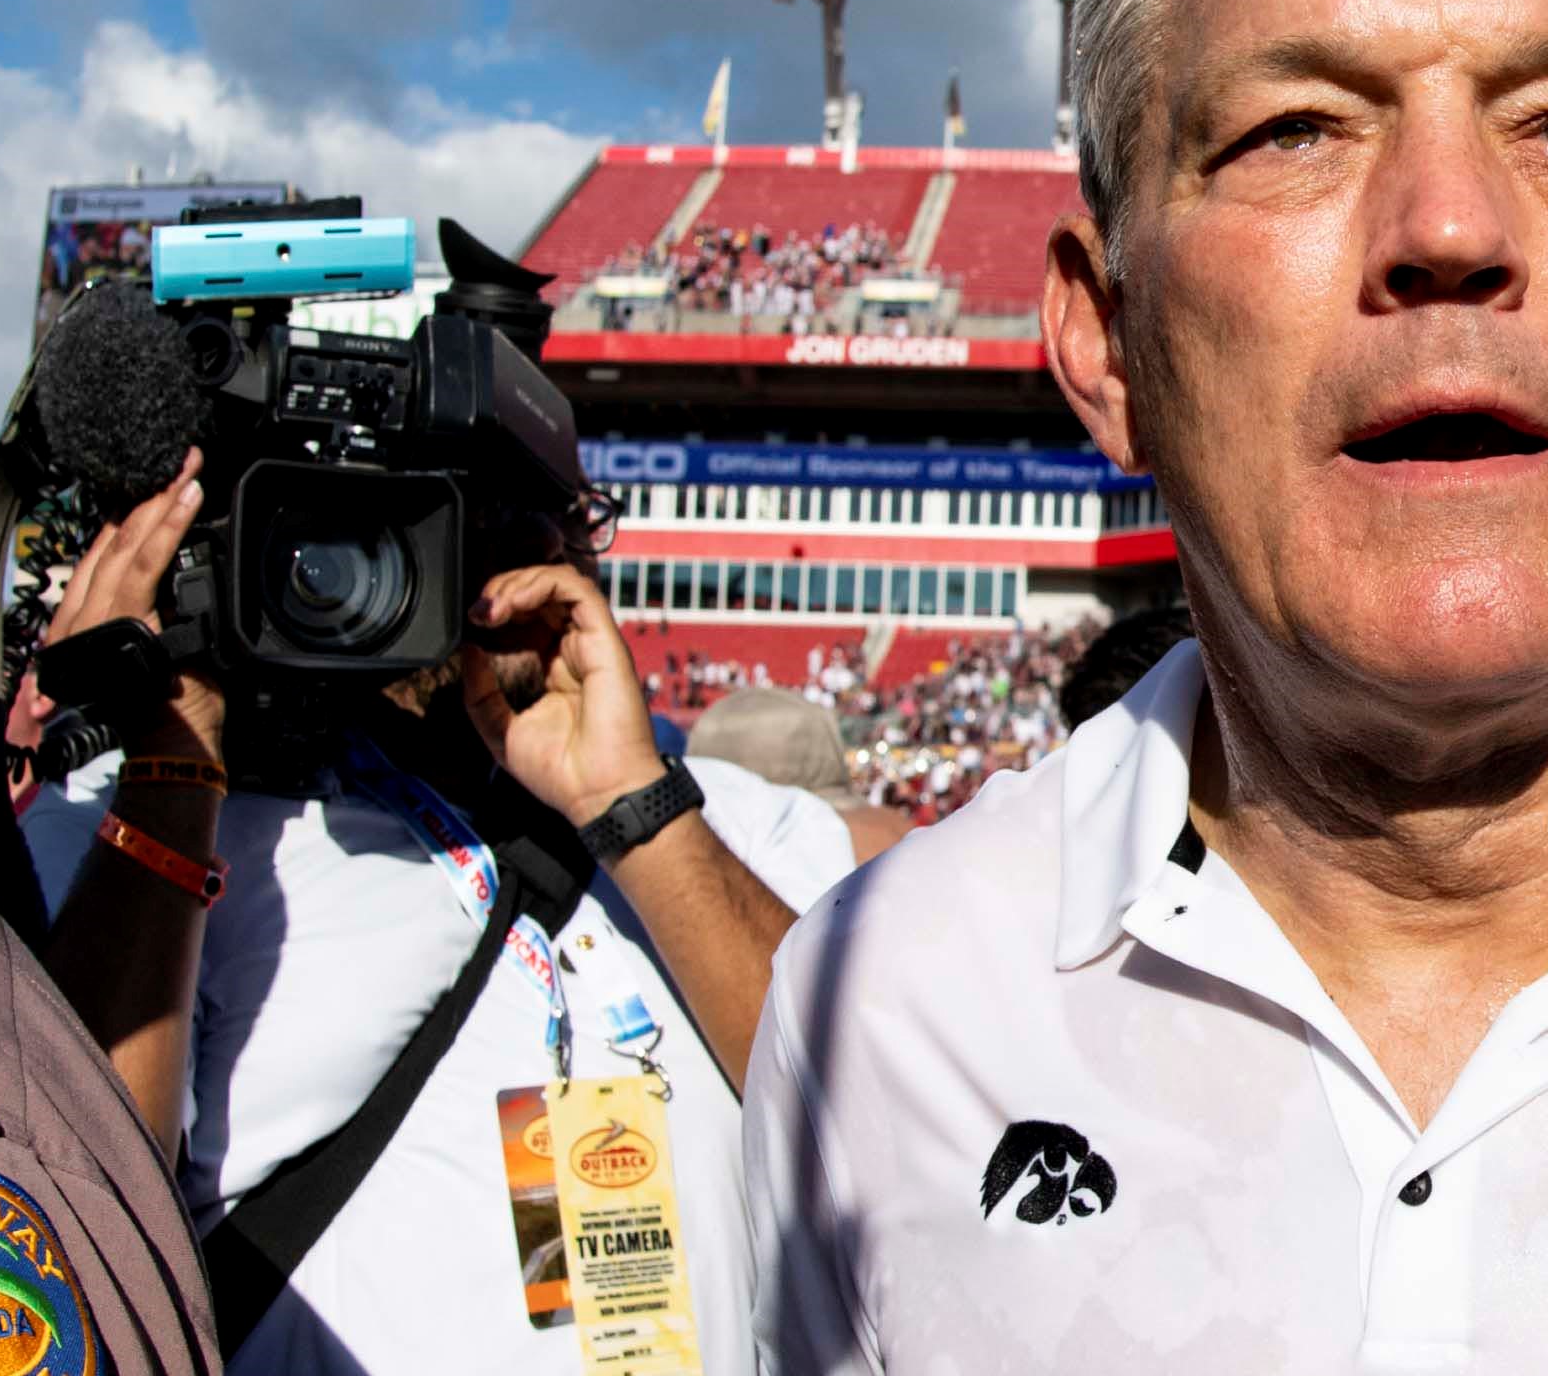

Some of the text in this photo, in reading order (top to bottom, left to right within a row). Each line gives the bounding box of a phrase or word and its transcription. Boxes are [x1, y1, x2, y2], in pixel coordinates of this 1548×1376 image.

[786, 336, 971, 365] JON GRUDEN
[579, 445, 686, 480] EICO
[708, 453, 799, 476] Official
[808, 453, 921, 481] Sponsor
[927, 454, 958, 479] of
[964, 456, 1011, 480] the
[469, 870, 490, 902] TO
[580, 1154, 648, 1173] OUTBACK
[575, 1227, 674, 1260] TV CAMERA
